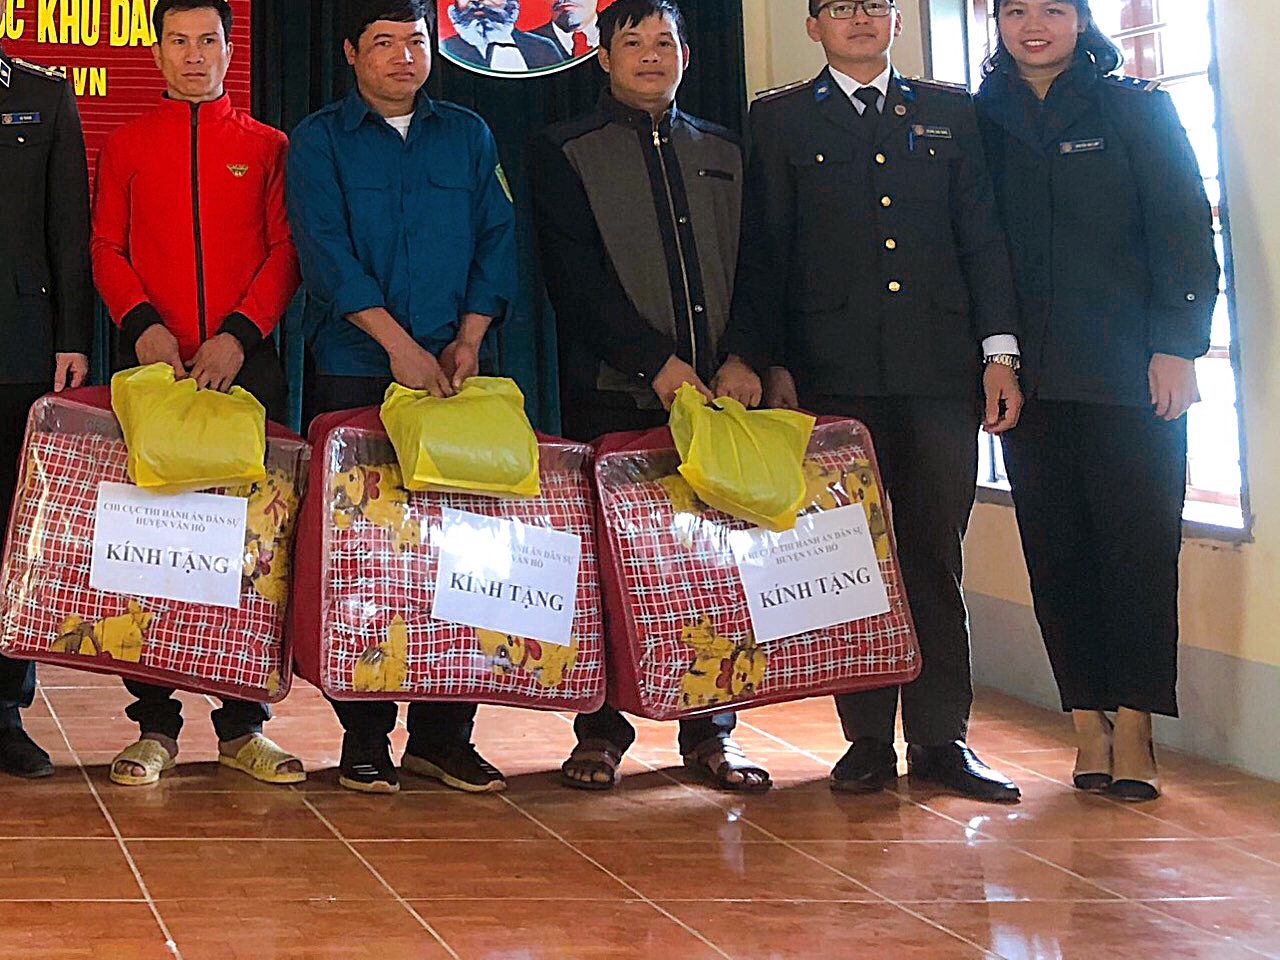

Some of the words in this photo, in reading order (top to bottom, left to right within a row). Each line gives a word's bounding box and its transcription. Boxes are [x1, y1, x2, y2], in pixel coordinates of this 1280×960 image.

[106, 540, 162, 565] KÍNH
[168, 551, 230, 575] TẶNG
[450, 571, 503, 599] KÍNH
[509, 584, 565, 612] TẶNG
[760, 583, 812, 609] KÍNH
[815, 567, 871, 595] TẶNG
